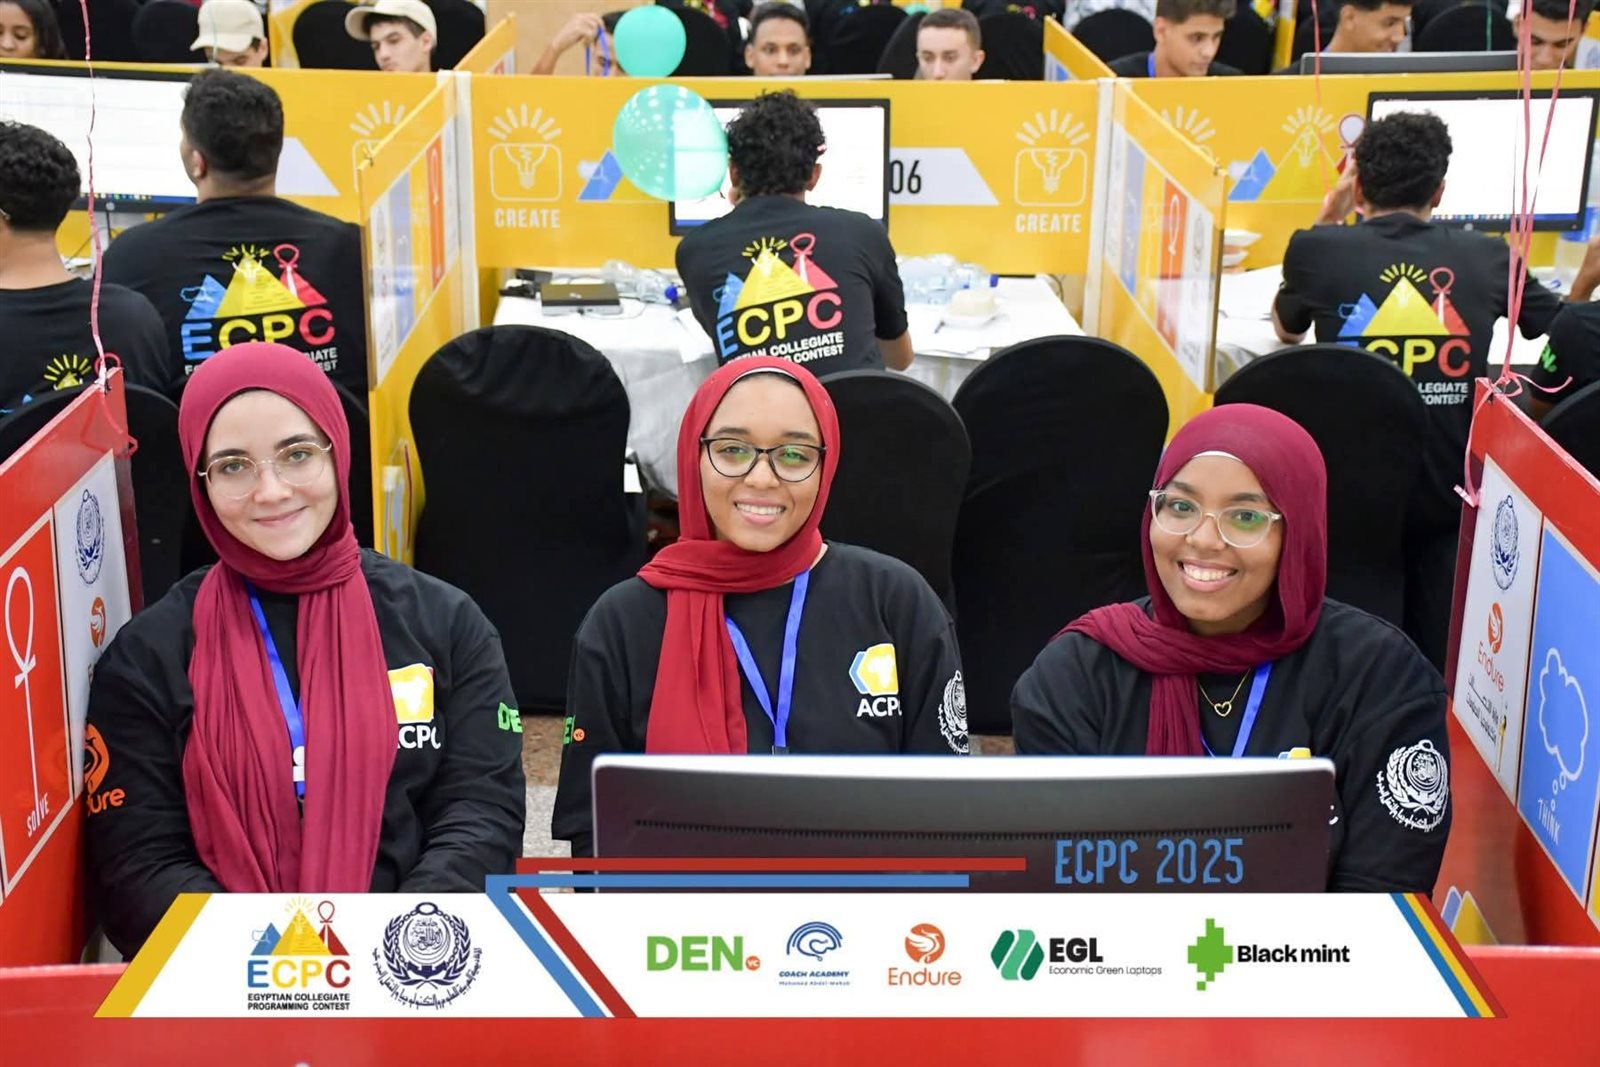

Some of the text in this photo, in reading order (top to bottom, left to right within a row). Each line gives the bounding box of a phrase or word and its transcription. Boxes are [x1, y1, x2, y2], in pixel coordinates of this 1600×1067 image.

[495, 208, 560, 229] CREATE
[1015, 213, 1081, 234] CREATE
[181, 308, 336, 361] ECPC
[716, 291, 843, 358] ECPC
[769, 331, 844, 357] COLLEGIATE
[793, 344, 844, 364] CONTEST
[1421, 394, 1467, 405] ONTEST
[1477, 640, 1505, 692] Endure
[1537, 797, 1561, 846] THINK
